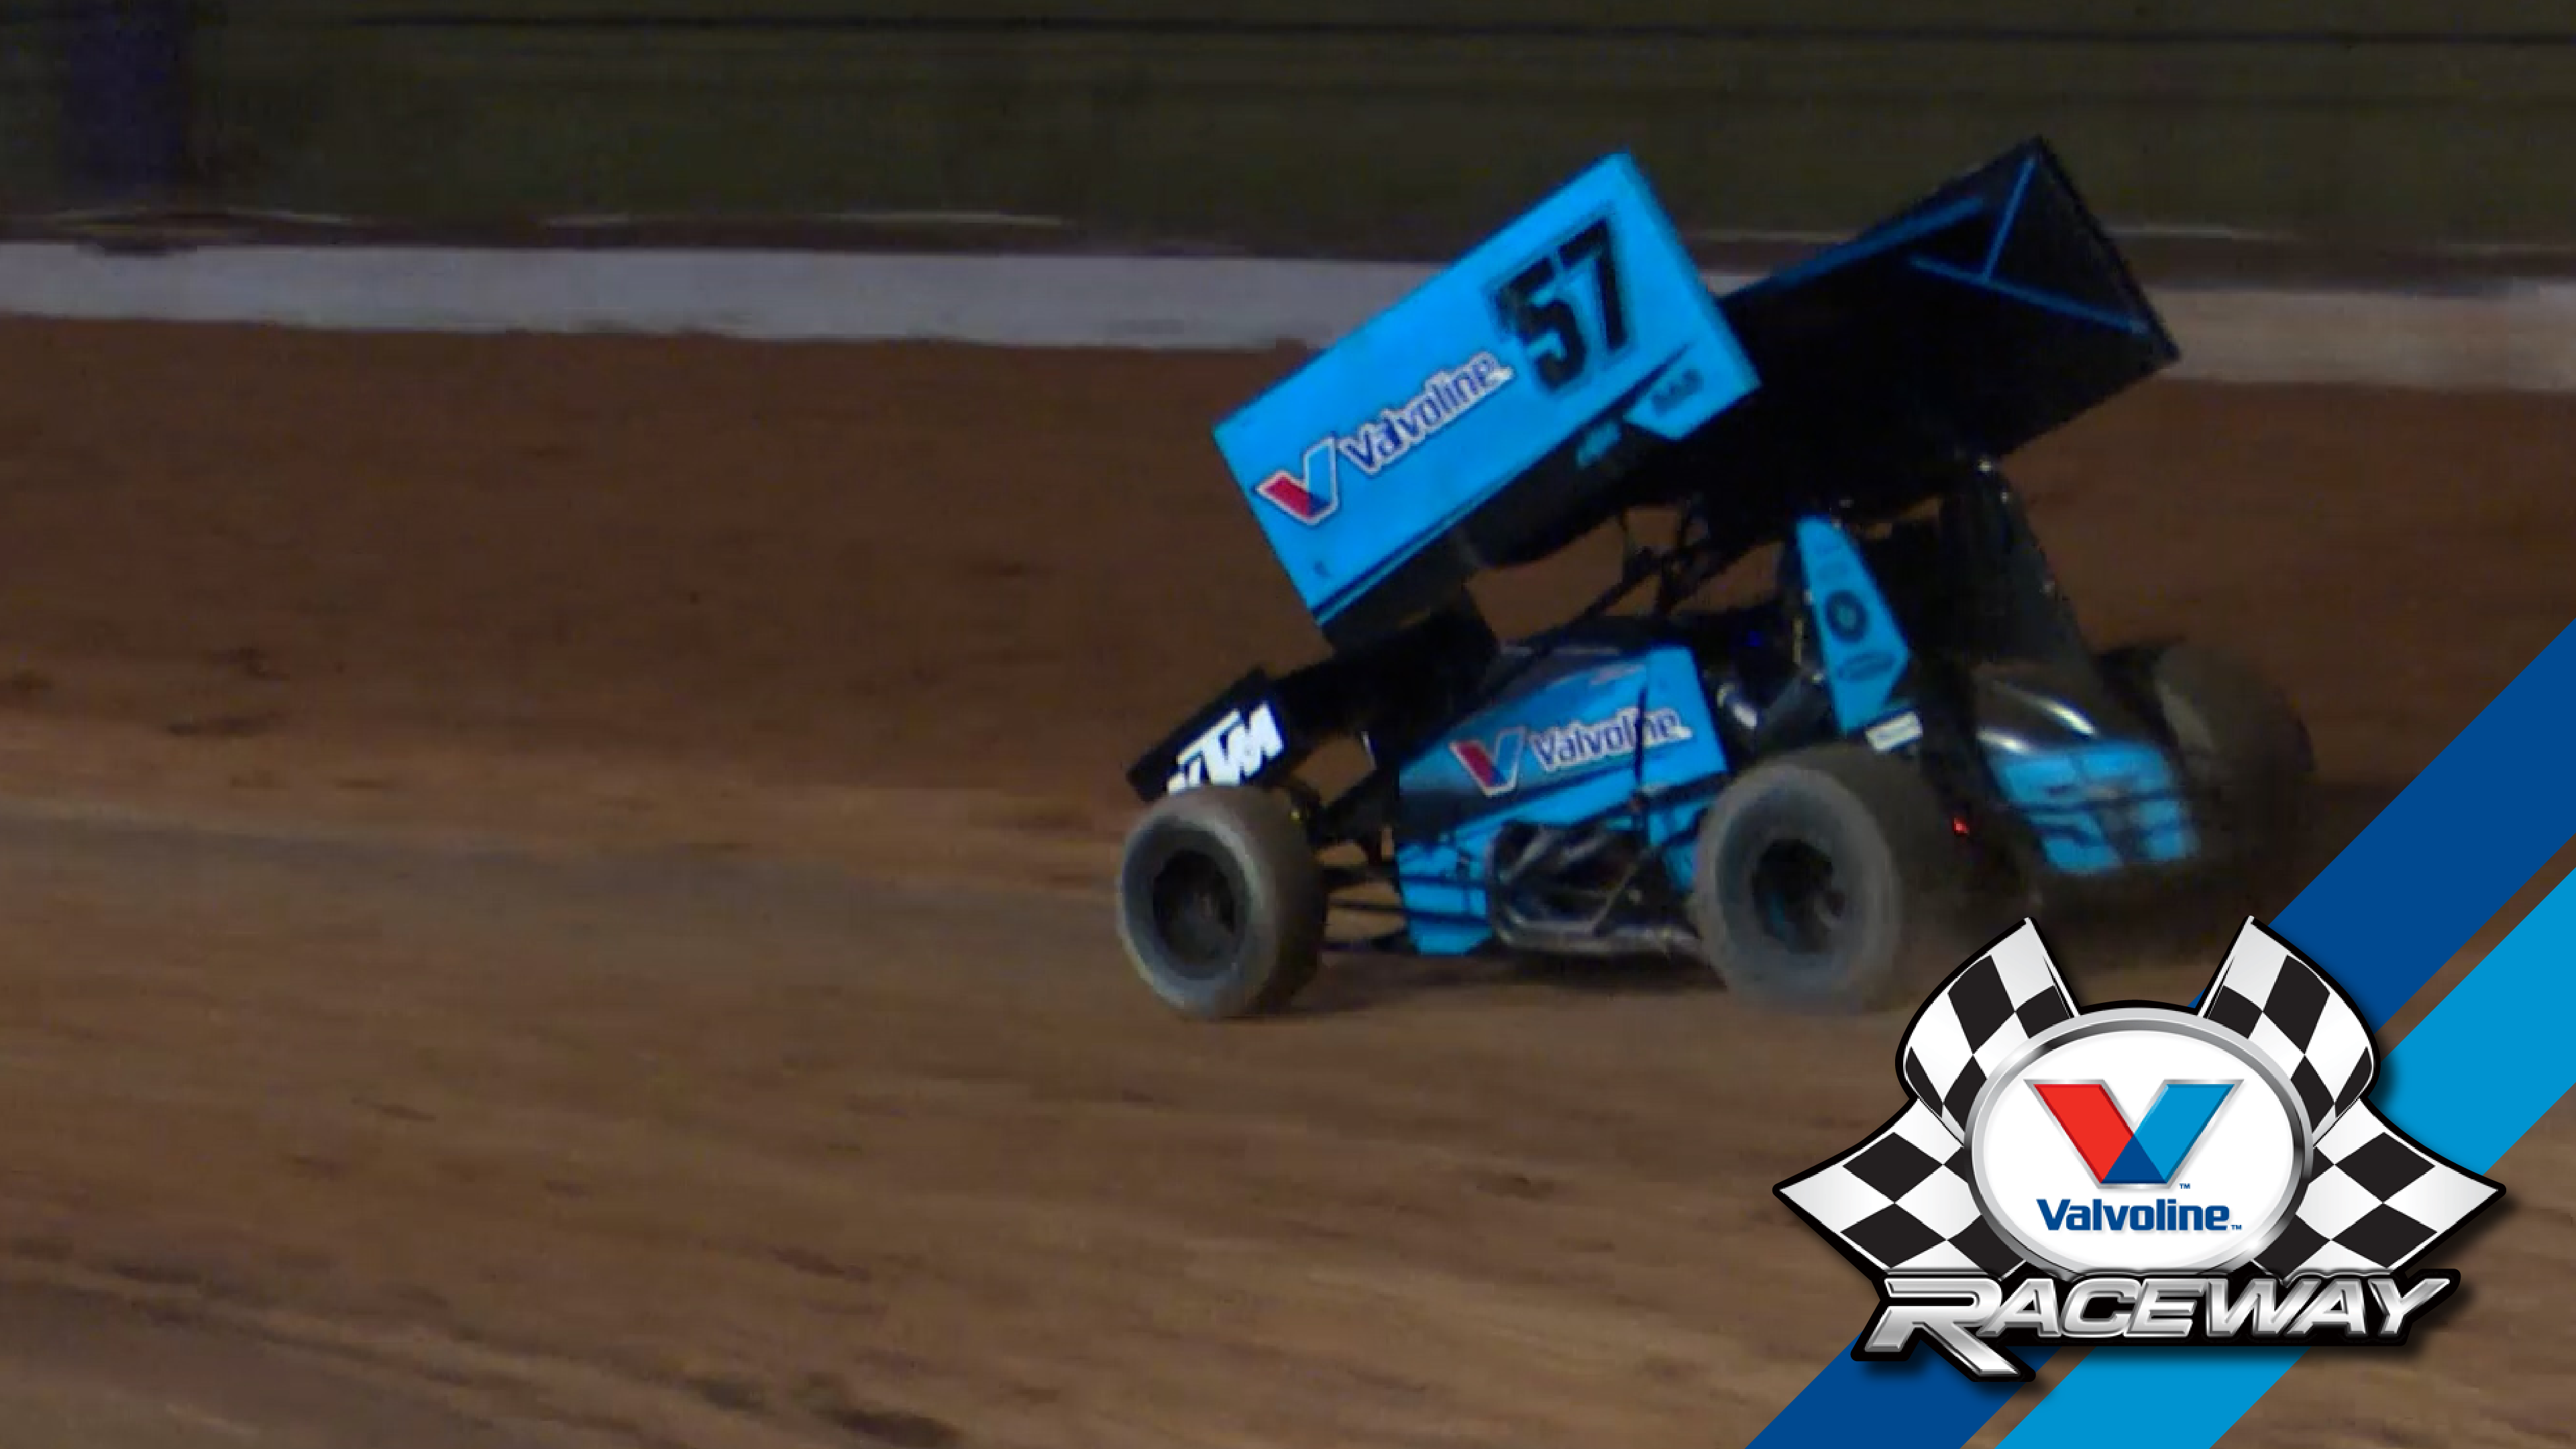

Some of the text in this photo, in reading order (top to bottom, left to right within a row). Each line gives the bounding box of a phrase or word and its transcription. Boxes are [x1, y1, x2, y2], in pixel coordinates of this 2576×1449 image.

[1493, 216, 1630, 392] 57
[1340, 354, 1509, 474] Valvoline
[1529, 708, 1689, 771] Valvolne
